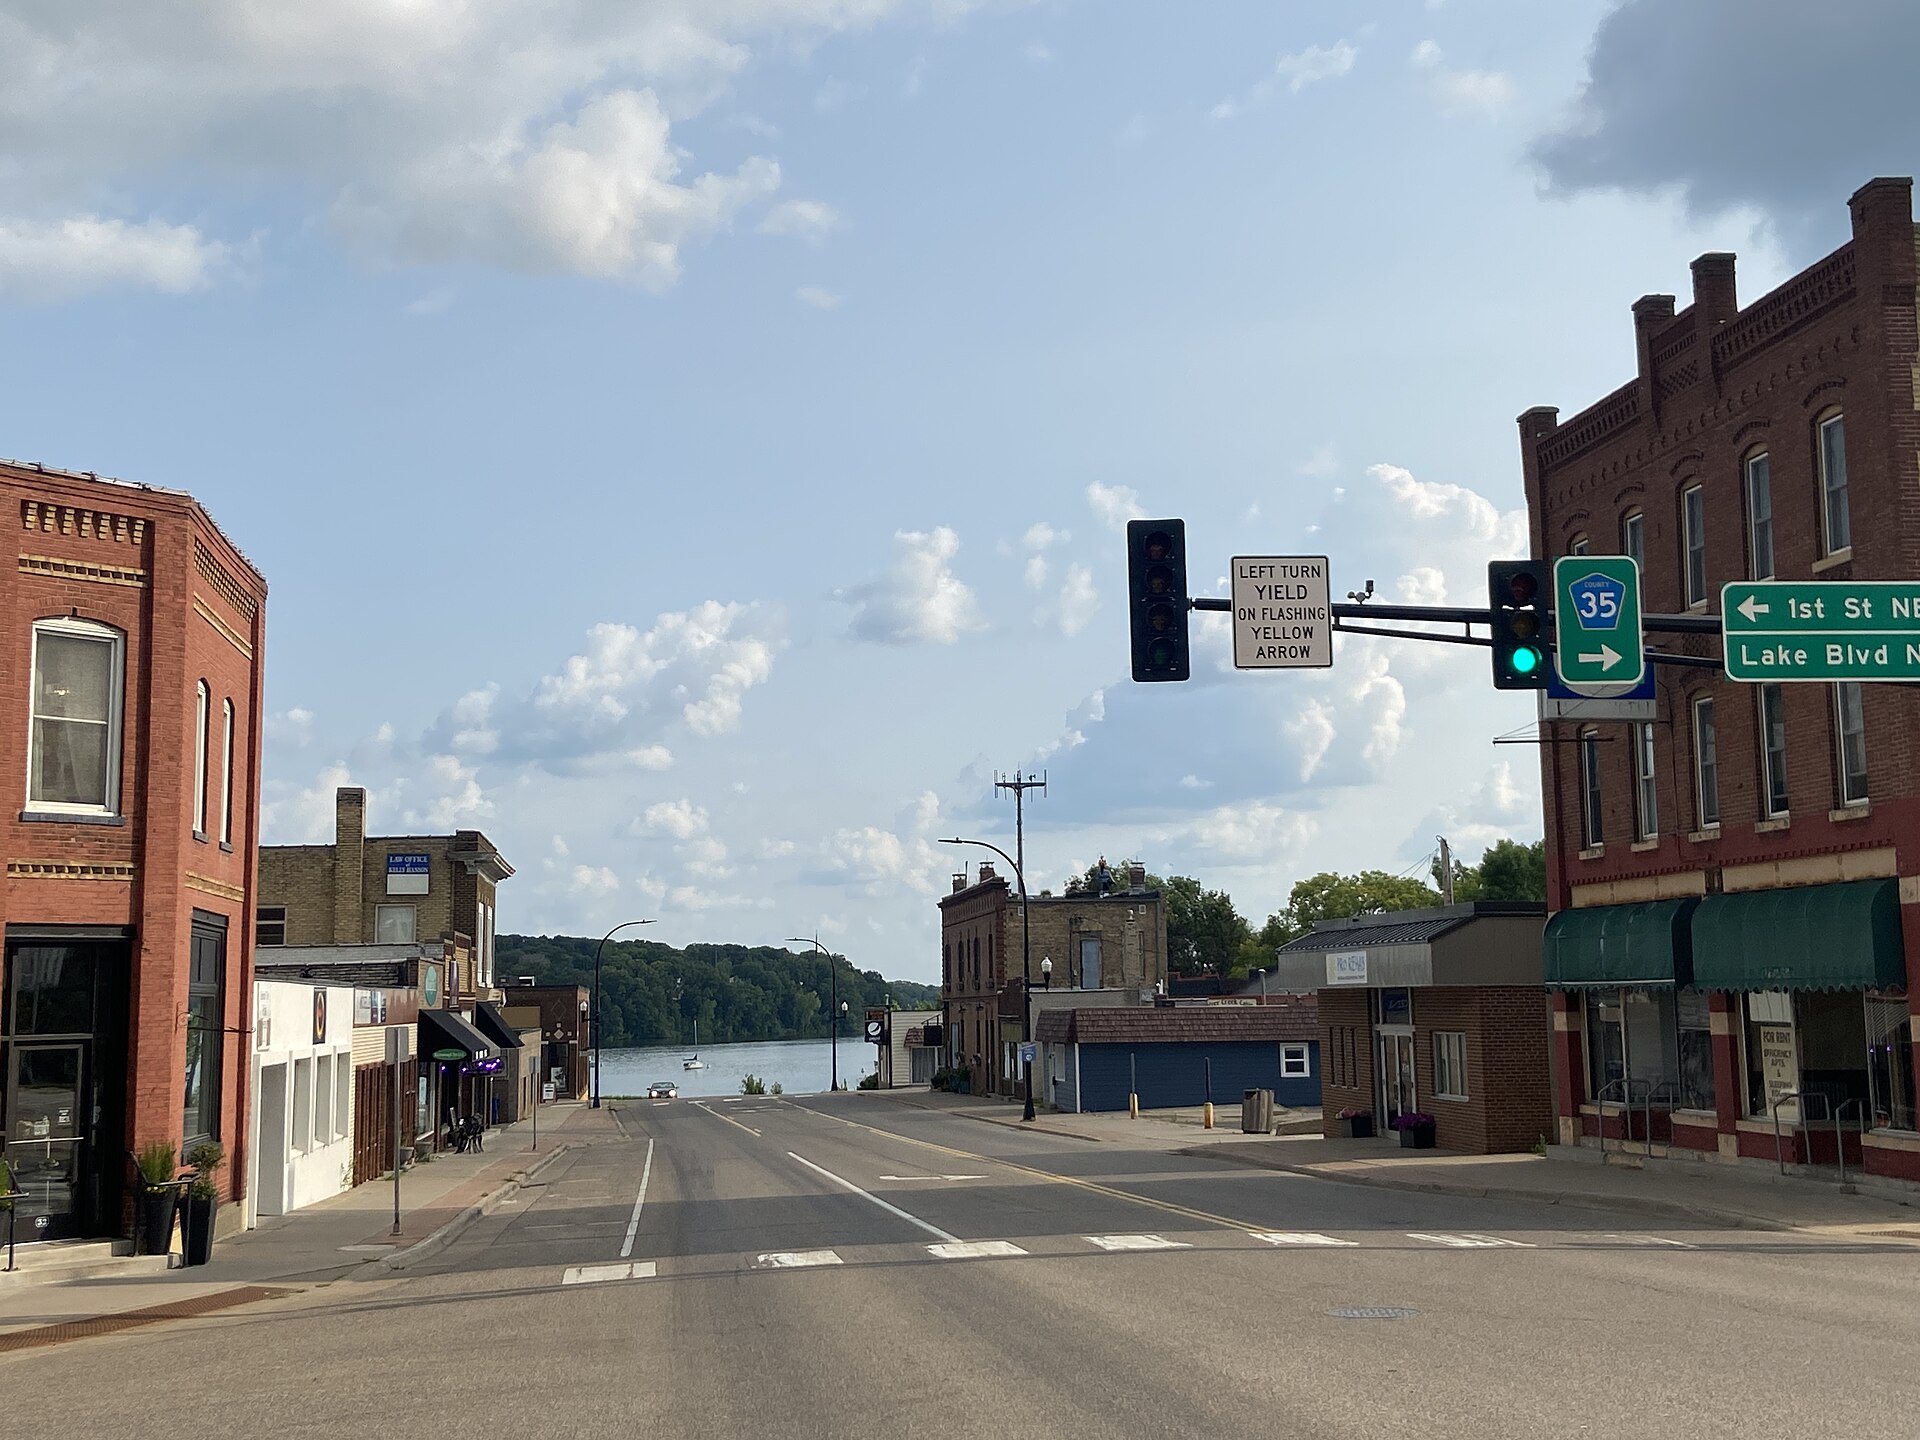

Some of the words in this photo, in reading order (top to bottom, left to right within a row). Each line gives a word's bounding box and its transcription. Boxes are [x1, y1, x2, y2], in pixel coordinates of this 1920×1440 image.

[1240, 565, 1275, 578] LEFT
[1281, 565, 1320, 578] TURN
[1254, 585, 1307, 600] YIELD
[1580, 592, 1616, 618] 35
[1788, 598, 1824, 618] 1st
[1844, 598, 1872, 618] St
[1238, 608, 1255, 620] ON
[1262, 607, 1325, 620] FLASHING
[1251, 626, 1313, 639] YELLOW
[1256, 645, 1310, 659] ARROW
[1741, 644, 1807, 666] Lake
[1826, 644, 1888, 666] Blvd
[1763, 1032, 1774, 1043] FOR
[1776, 1032, 1790, 1044] RENT
